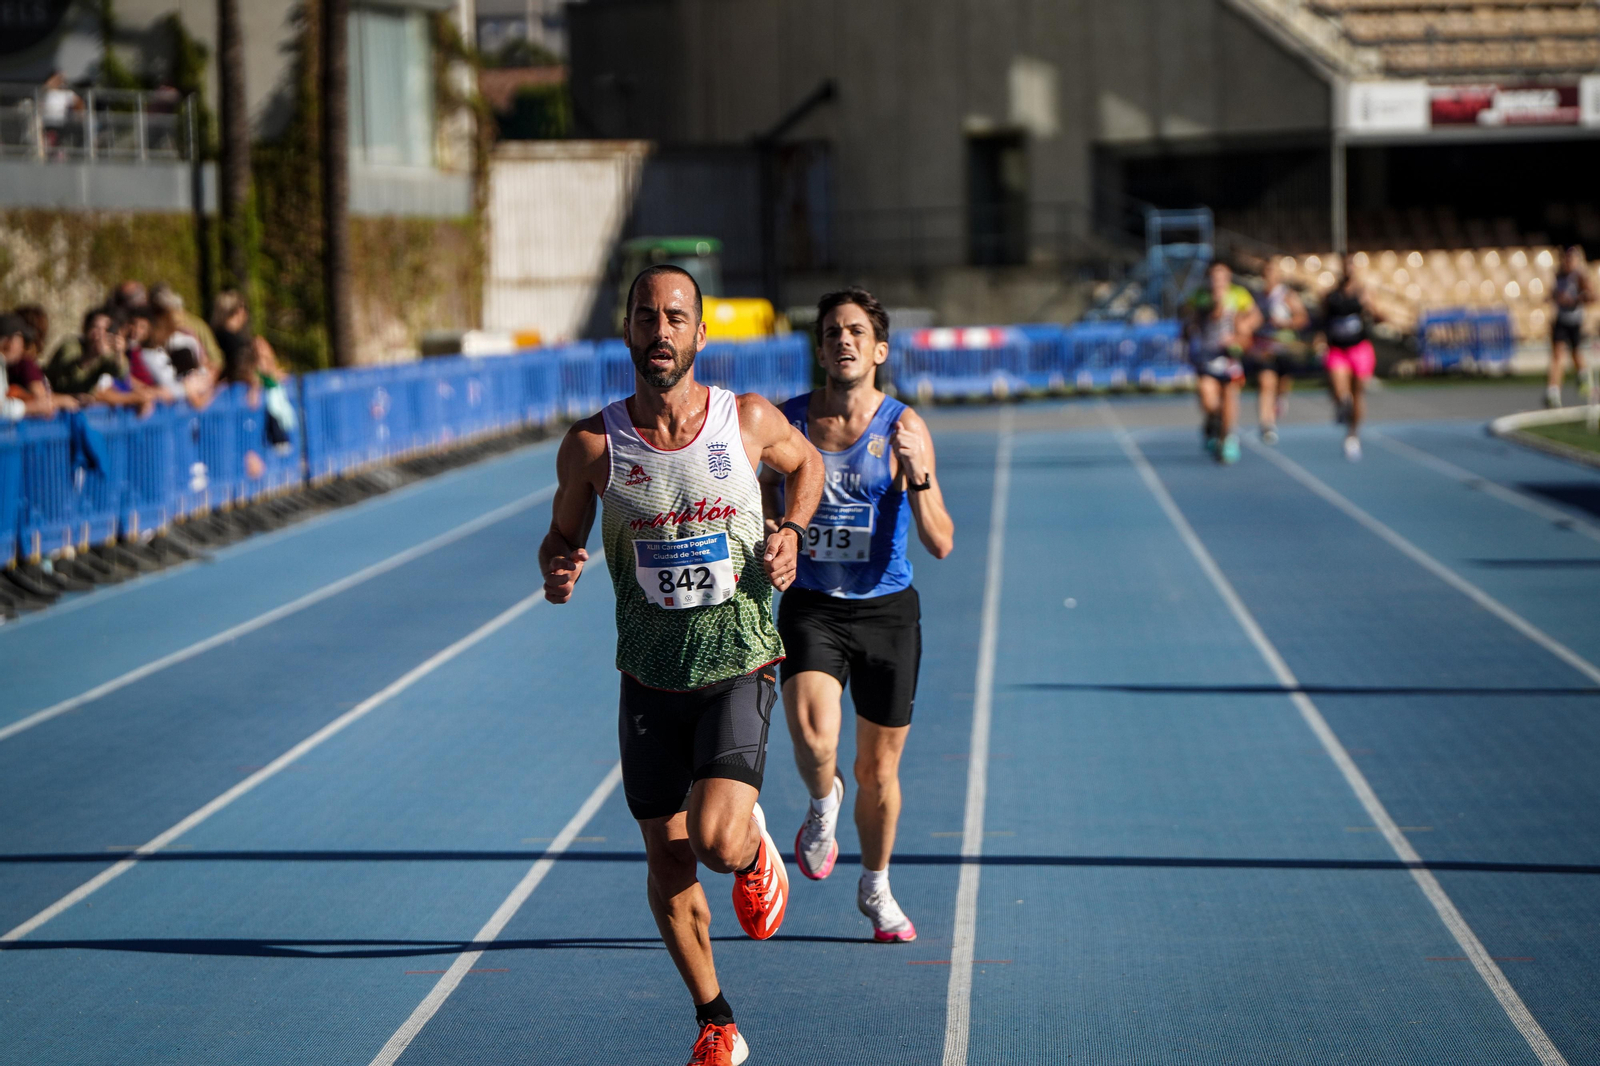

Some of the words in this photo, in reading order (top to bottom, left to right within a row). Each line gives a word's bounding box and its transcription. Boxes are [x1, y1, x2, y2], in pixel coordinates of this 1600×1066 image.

[630, 497, 737, 530] maratón
[646, 543, 660, 551] XLIII
[661, 542, 689, 551] Carrera
[690, 537, 718, 547] Popular
[807, 526, 851, 549] 913
[690, 549, 711, 557] Jerez
[658, 566, 714, 594] 842
